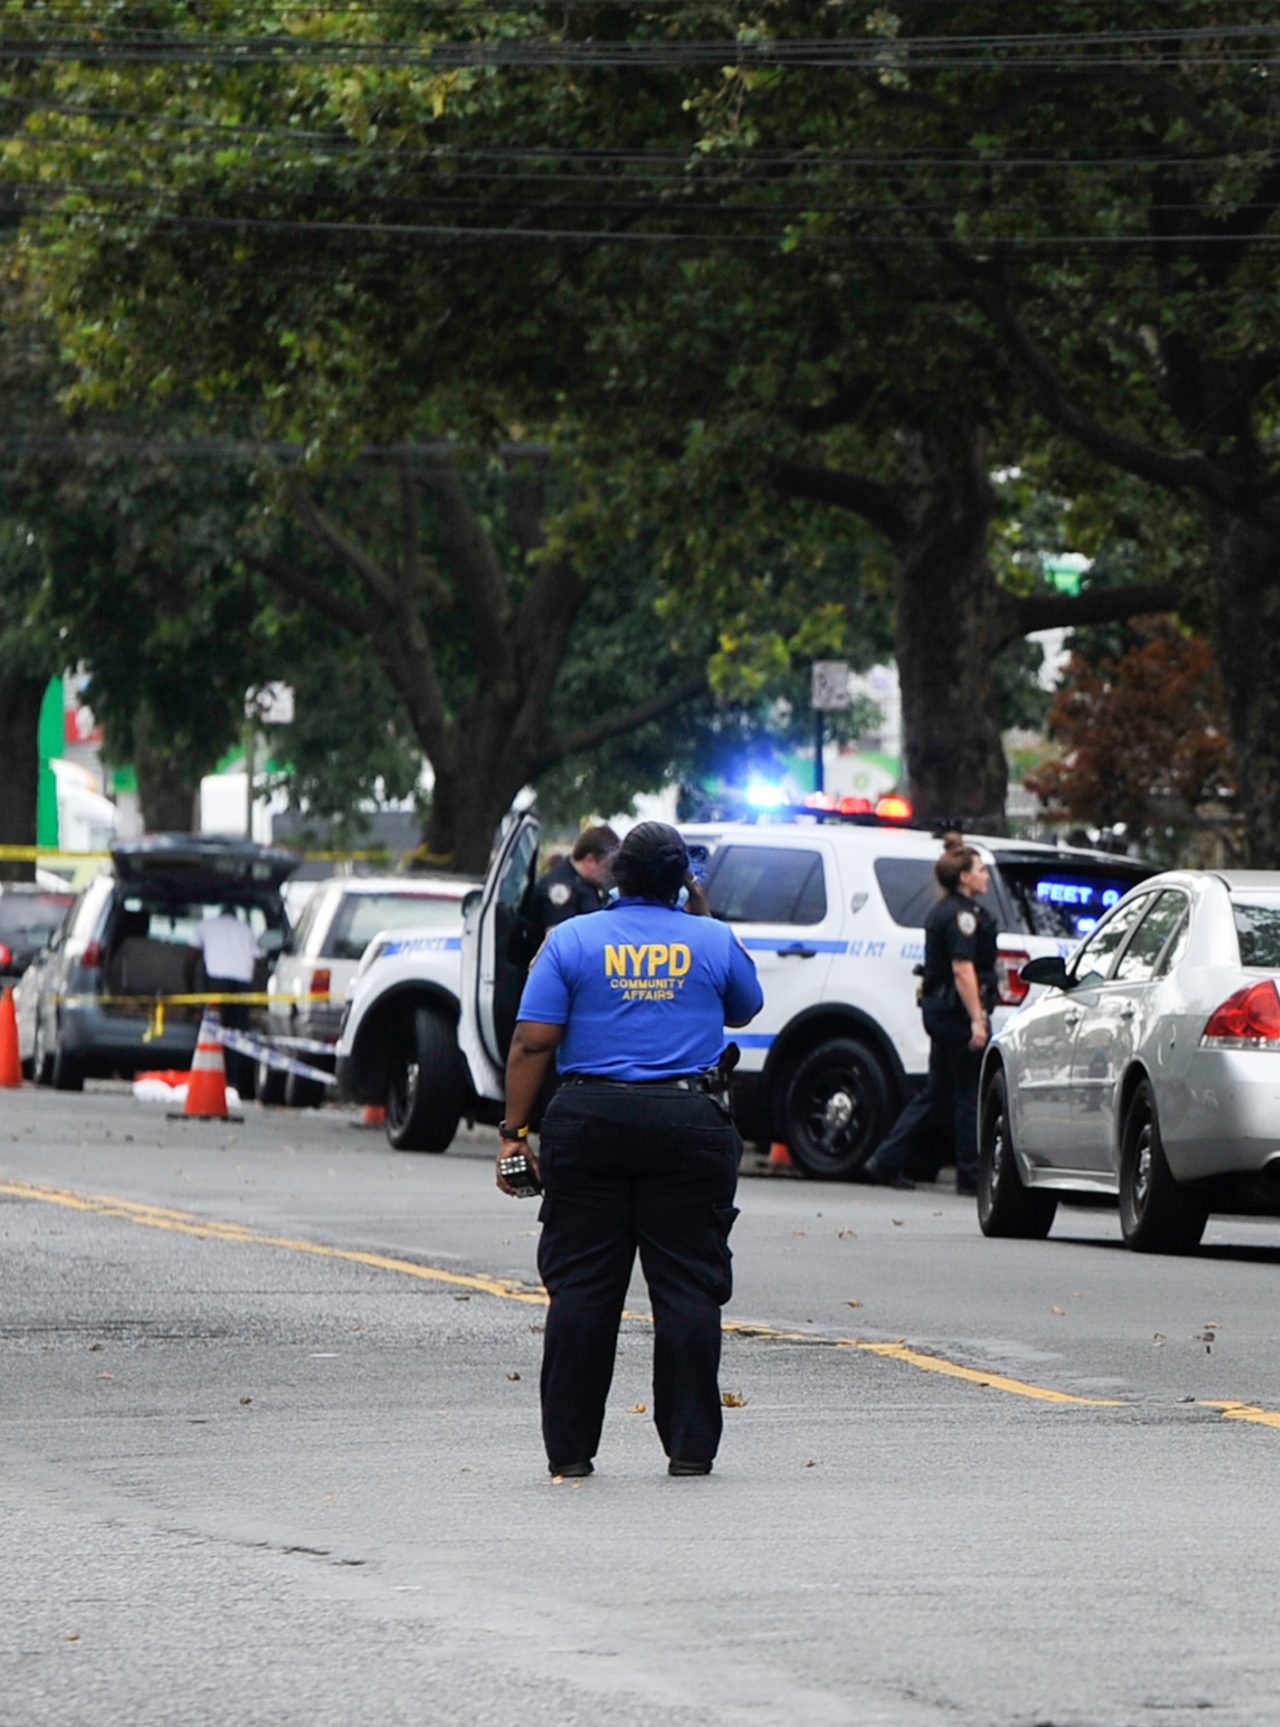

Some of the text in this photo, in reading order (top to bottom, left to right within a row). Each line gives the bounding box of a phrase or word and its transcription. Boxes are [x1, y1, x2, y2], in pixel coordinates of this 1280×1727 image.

[604, 944, 692, 977] NYPD
[610, 978, 686, 989] COMMUNITY
[622, 990, 675, 1001] AFFAIRS
